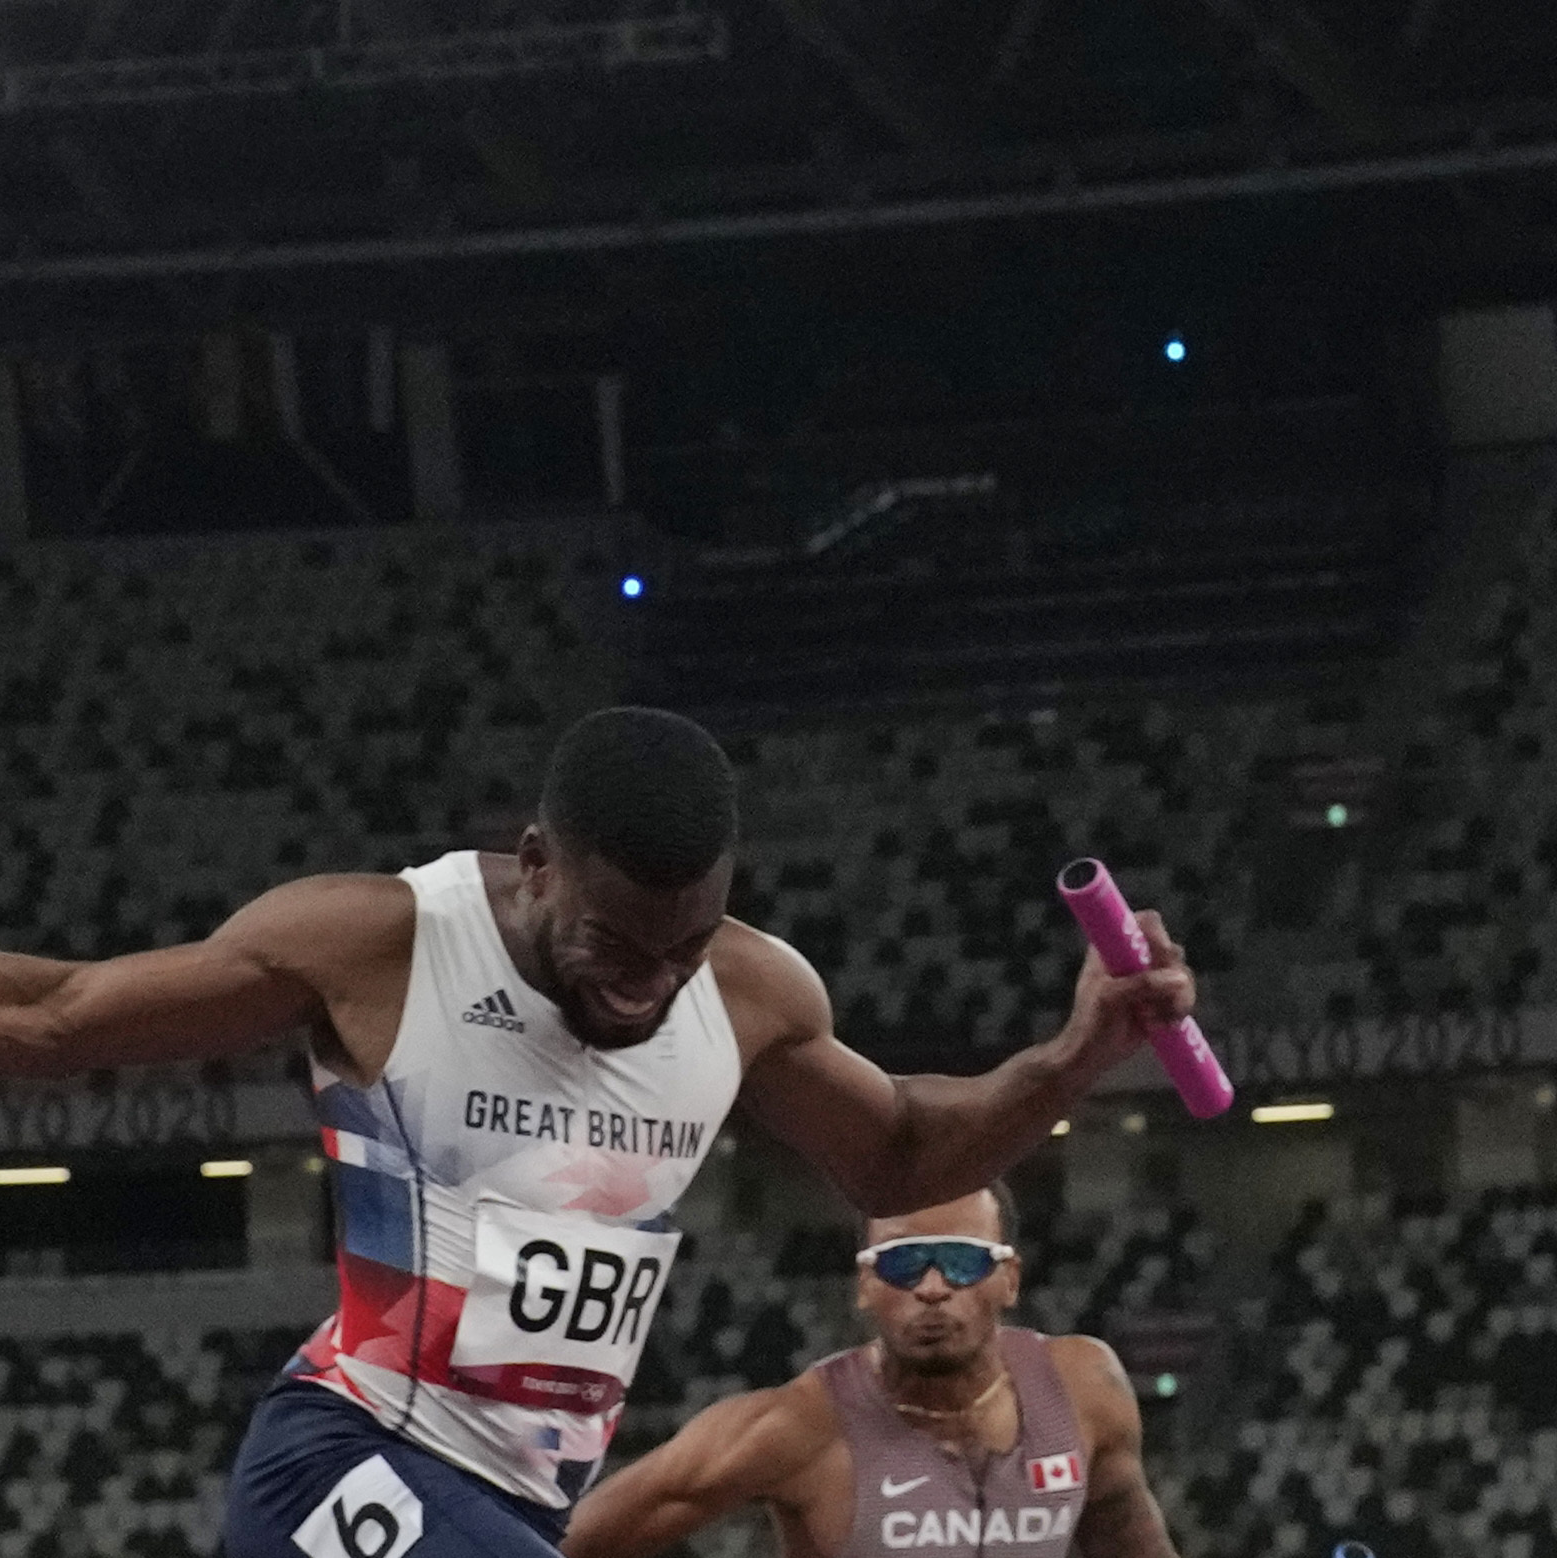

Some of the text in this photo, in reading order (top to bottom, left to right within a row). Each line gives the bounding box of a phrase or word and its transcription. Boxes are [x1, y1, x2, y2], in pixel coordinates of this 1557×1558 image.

[463, 1011, 525, 1034] adidas
[1388, 1009, 1523, 1071] 2020
[99, 1083, 237, 1148] 2020
[465, 1089, 705, 1159] GREAT BRITAIN
[509, 1240, 661, 1346] GBR
